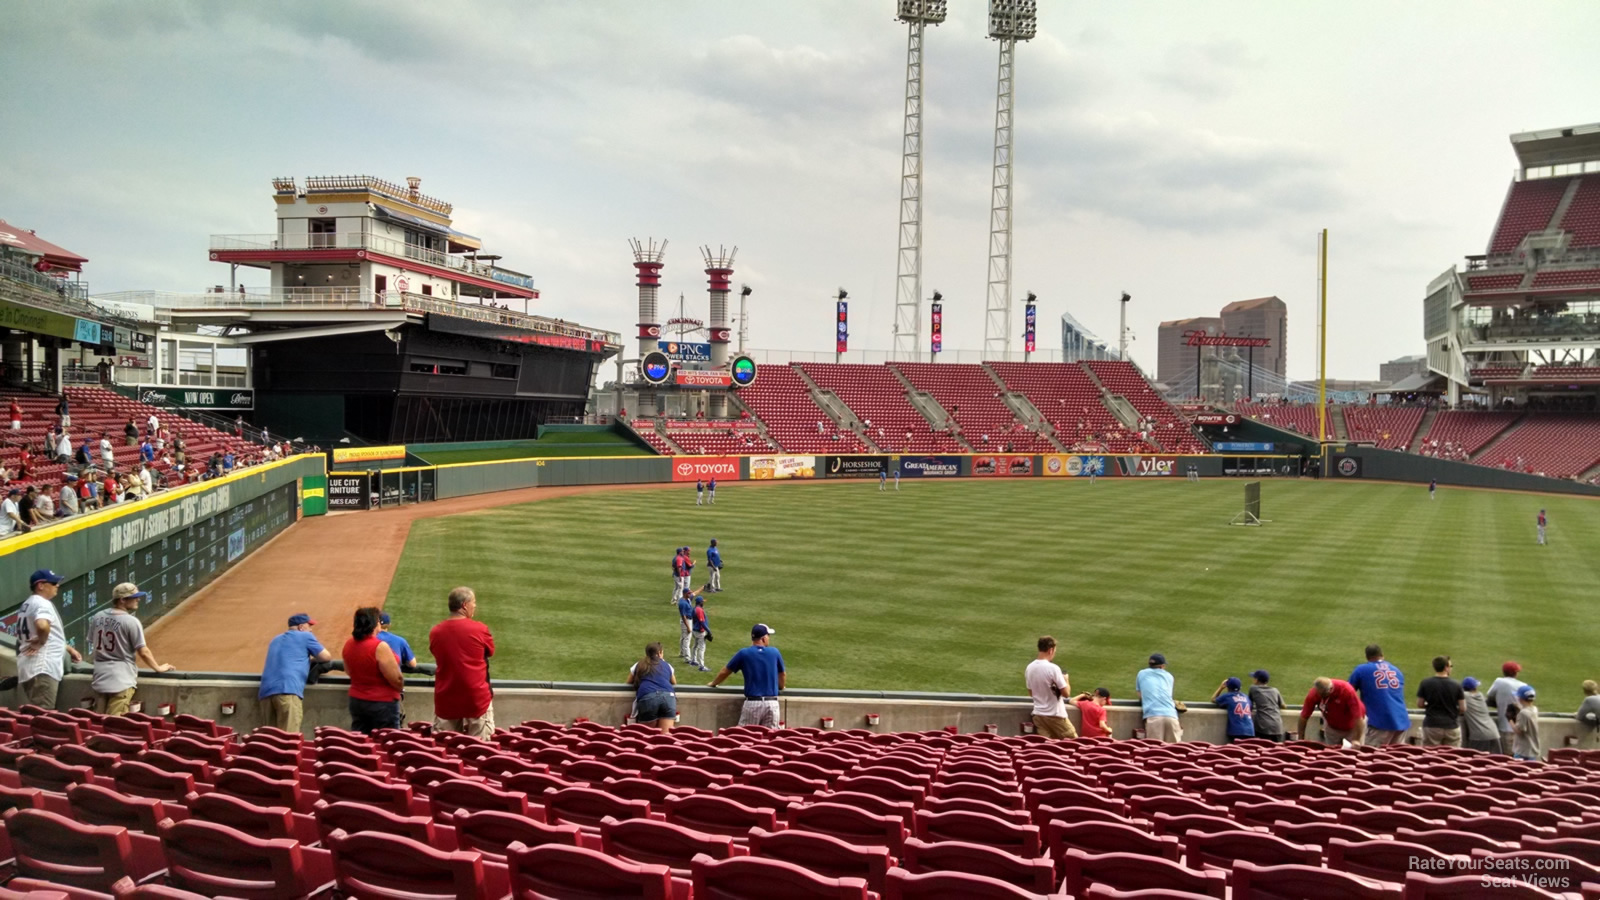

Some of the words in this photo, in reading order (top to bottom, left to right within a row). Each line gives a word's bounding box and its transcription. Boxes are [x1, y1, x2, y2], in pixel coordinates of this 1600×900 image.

[679, 343, 704, 355] PNC
[695, 376, 724, 385] TOYOTA
[184, 391, 199, 405] NOW
[199, 392, 215, 405] OPEN
[694, 463, 736, 474] TOYOTA
[109, 525, 122, 555] FOR
[122, 517, 145, 549] SAFETY
[148, 509, 169, 538] SERVICE
[169, 504, 181, 529] TEXT
[17, 616, 30, 640] 44
[95, 617, 120, 631] CASTRO
[96, 629, 115, 652] 13
[1373, 670, 1400, 689] 25
[1234, 702, 1252, 718] 44
